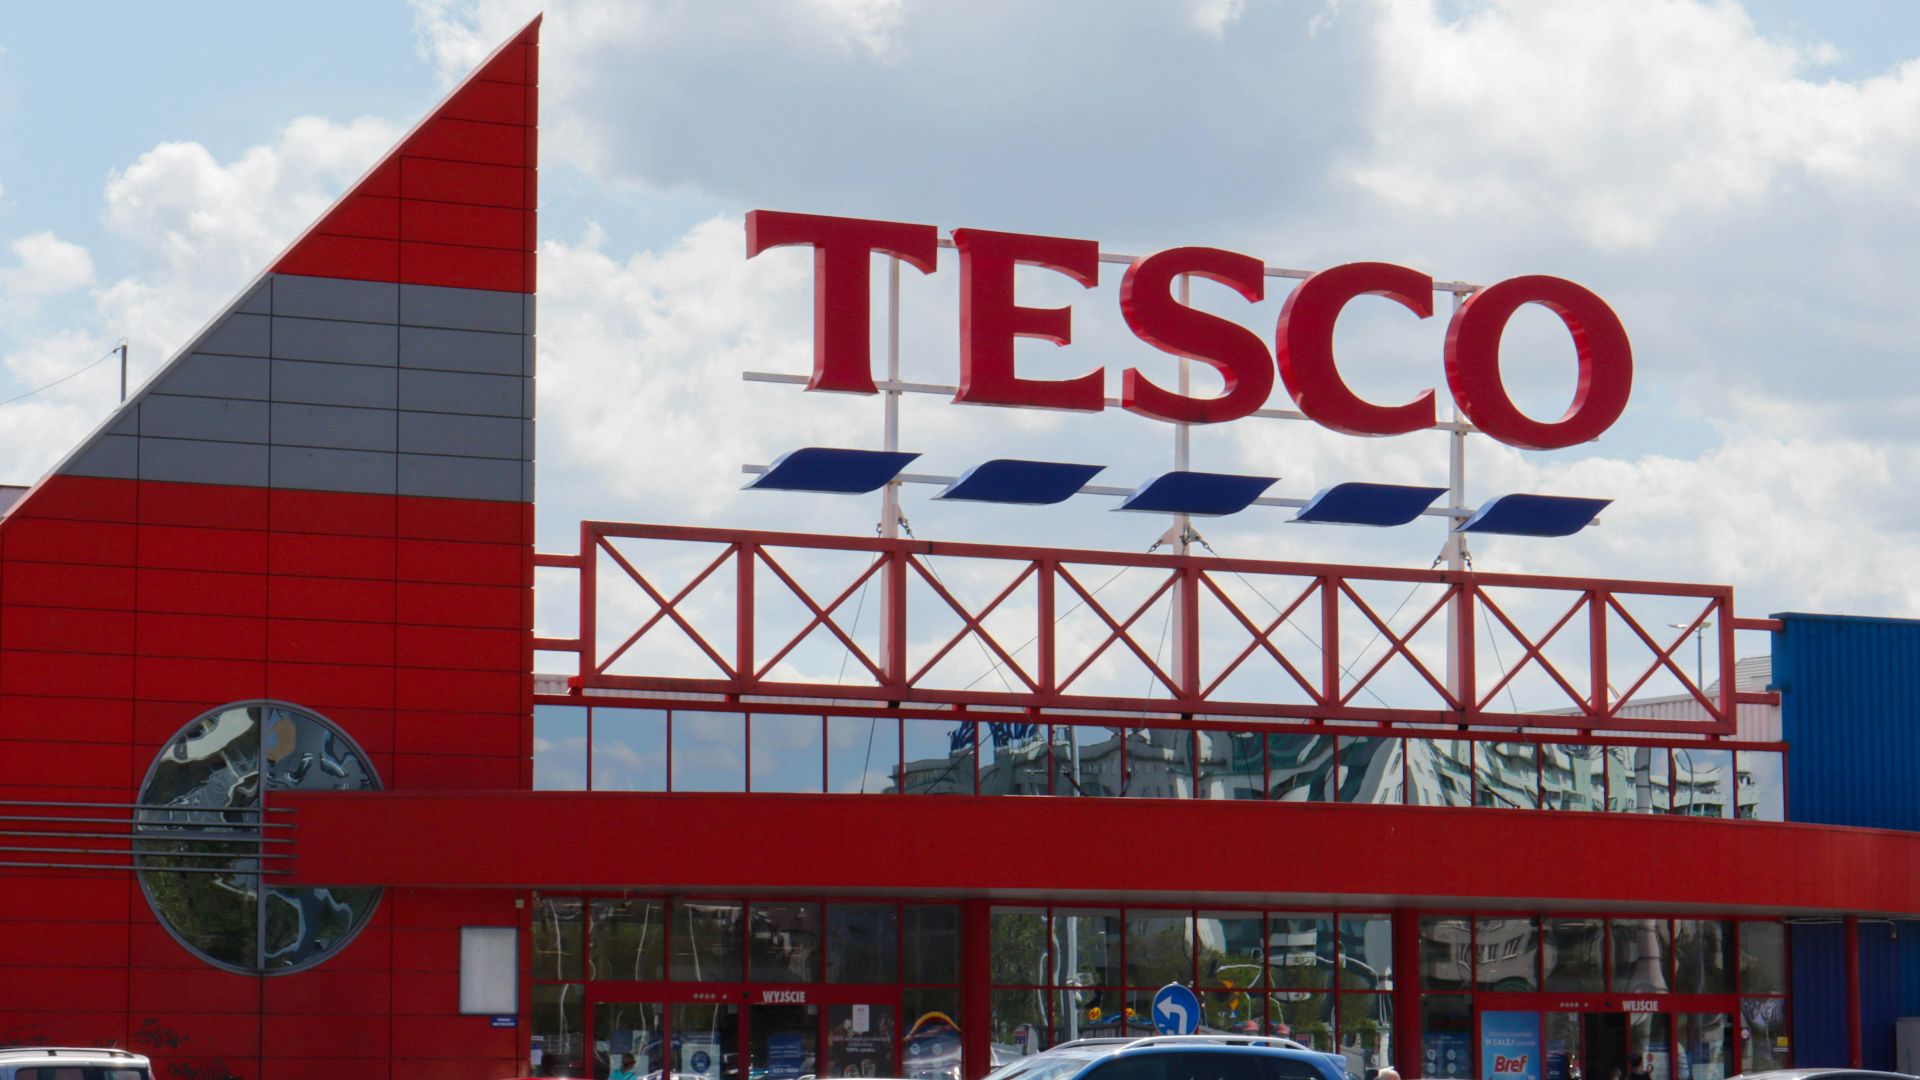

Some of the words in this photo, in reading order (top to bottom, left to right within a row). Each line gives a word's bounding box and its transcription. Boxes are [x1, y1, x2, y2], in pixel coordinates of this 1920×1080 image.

[745, 208, 1633, 450] TESCO
[762, 990, 806, 1003] WYJŚCIE
[1622, 1000, 1658, 1011] WEJŚCIE
[1494, 1055, 1528, 1073] Bref
